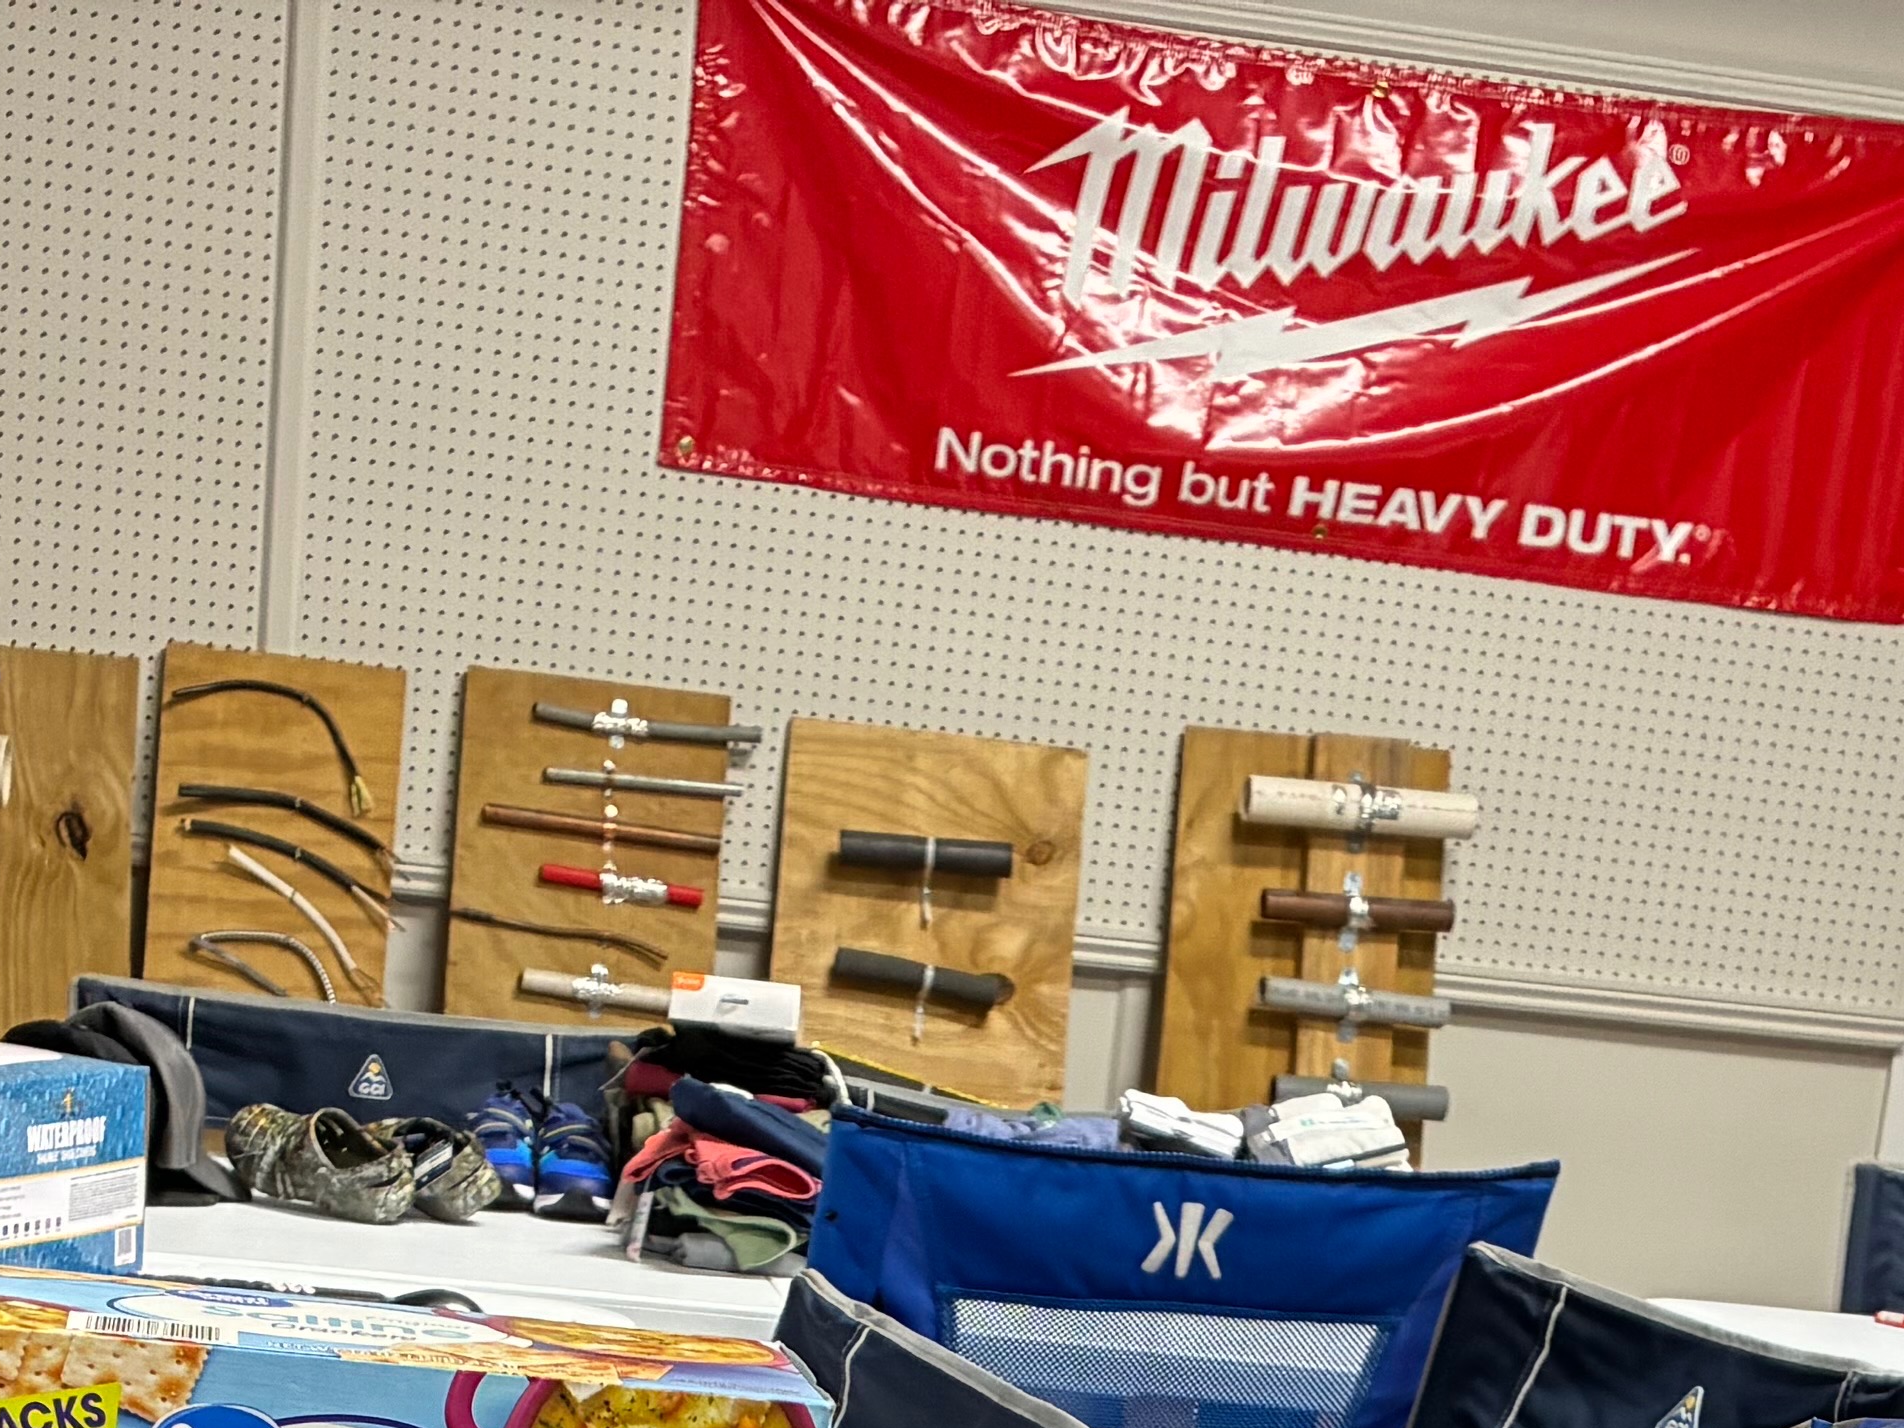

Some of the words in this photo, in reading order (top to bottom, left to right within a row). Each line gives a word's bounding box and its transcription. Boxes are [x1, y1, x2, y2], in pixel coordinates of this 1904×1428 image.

[1024, 105, 1688, 308] Milwaukee
[935, 426, 1162, 509] Nothing
[1177, 458, 1276, 516] but
[1289, 475, 1506, 541] HEAVY
[27, 1115, 106, 1153] WATERPROOF
